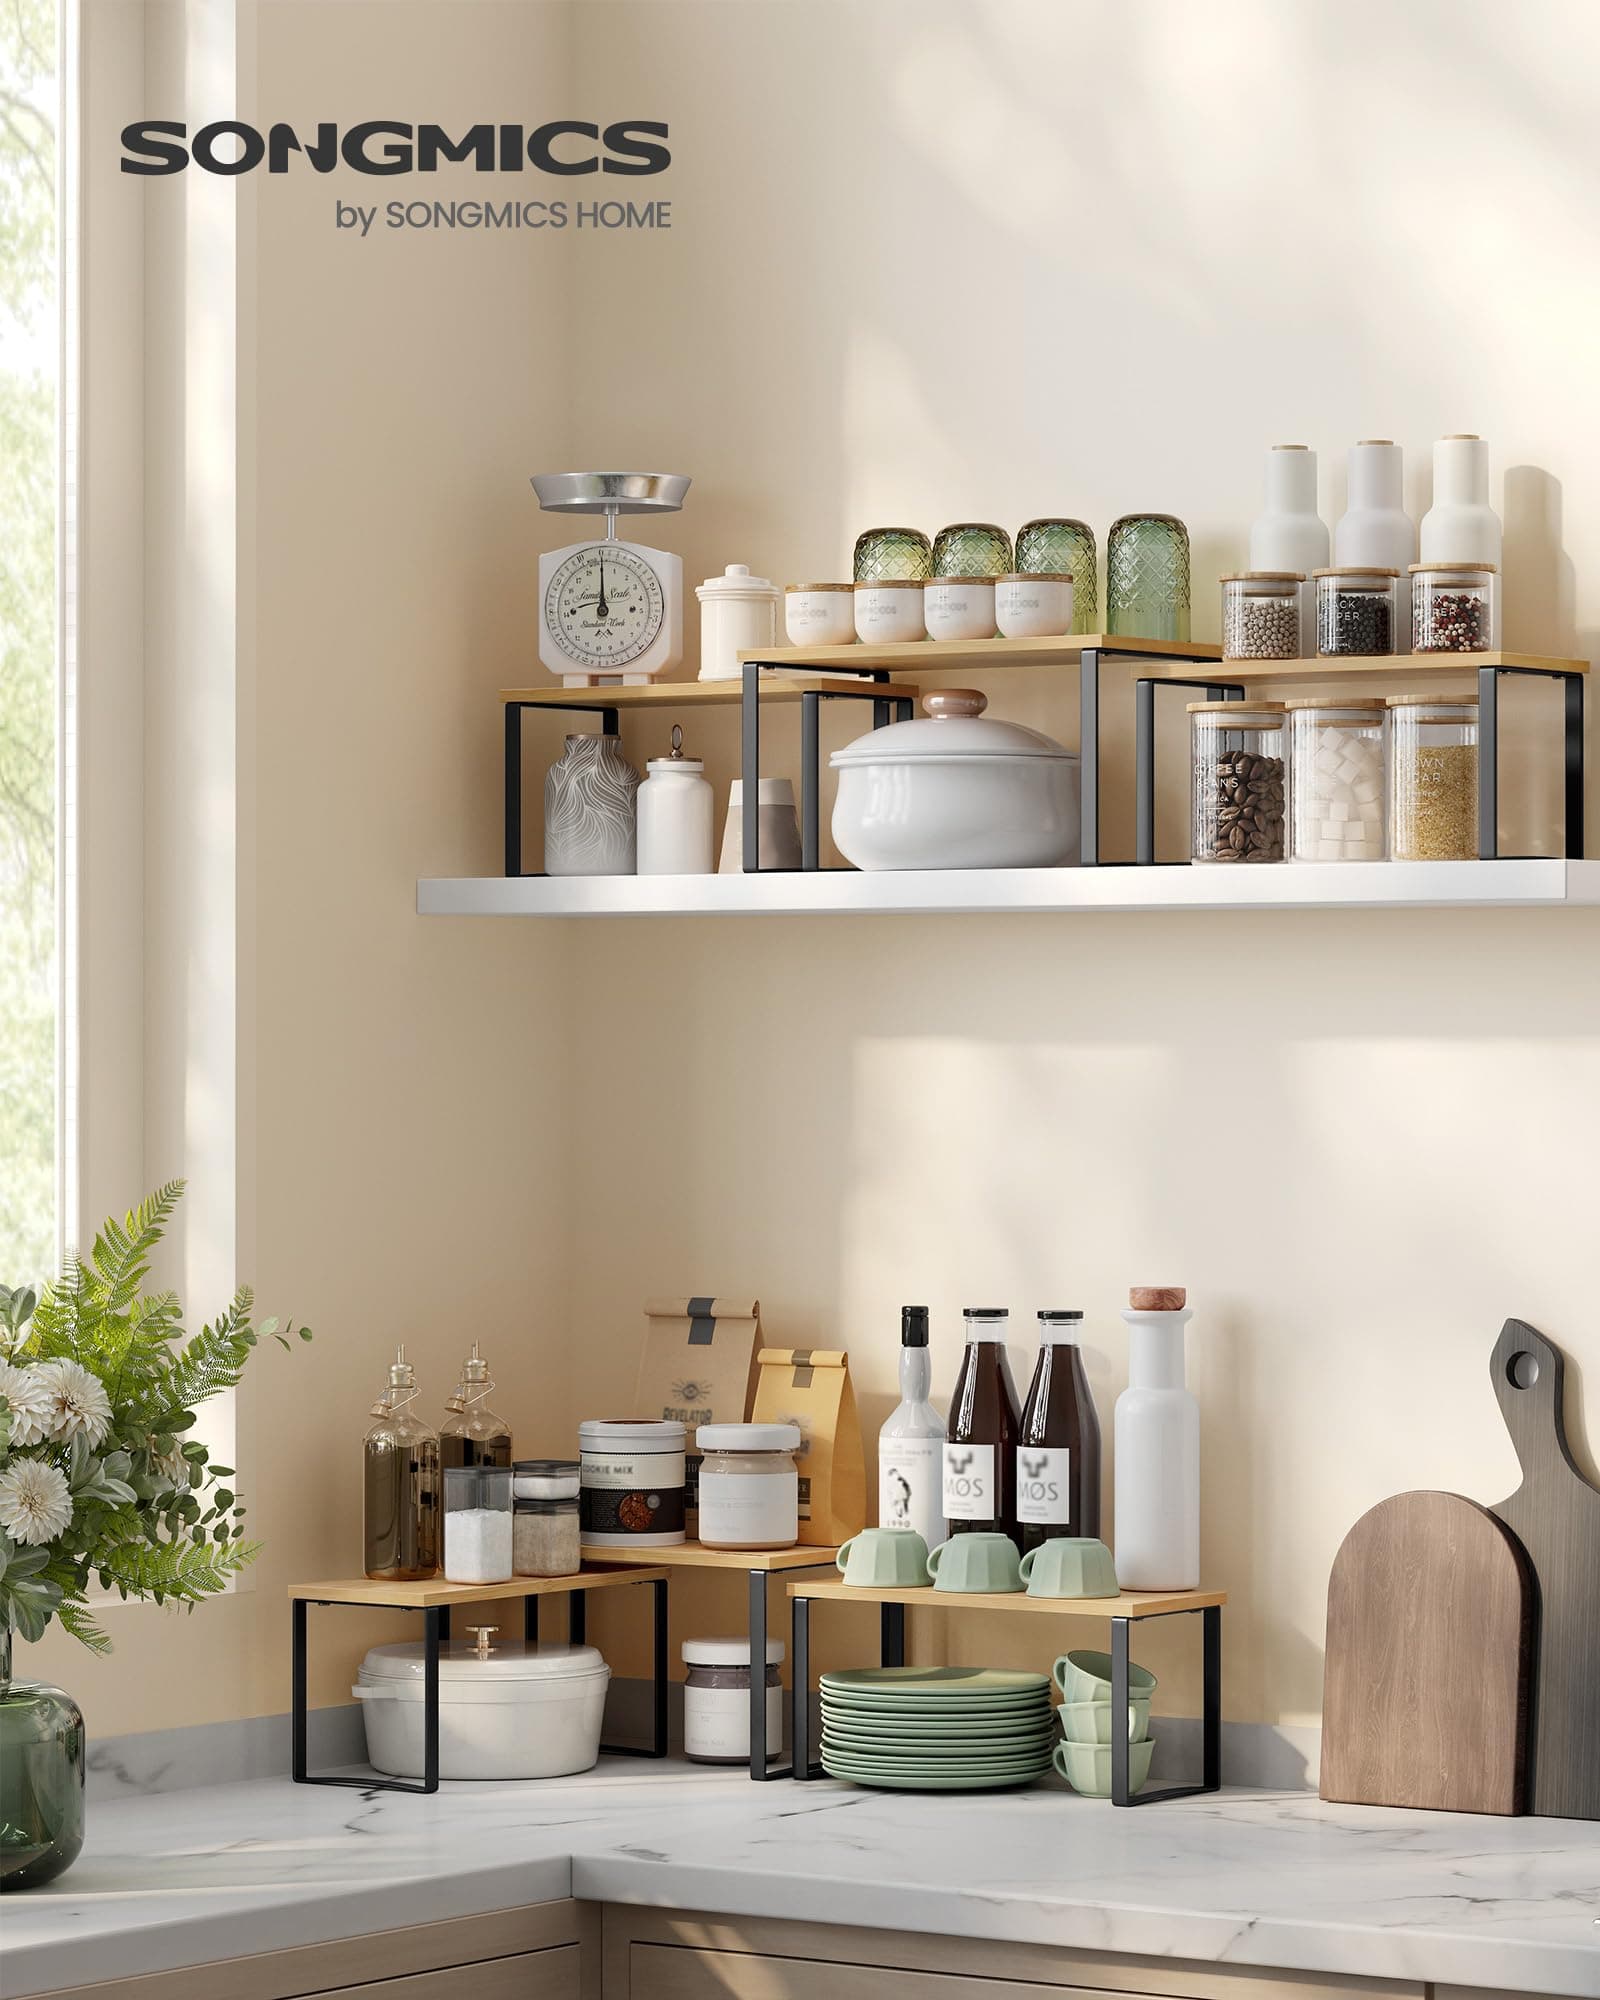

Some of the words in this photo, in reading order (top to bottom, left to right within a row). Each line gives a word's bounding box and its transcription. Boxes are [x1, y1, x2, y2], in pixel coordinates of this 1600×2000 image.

[1321, 600, 1356, 610] BACK
[1318, 611, 1360, 621] PEPER
[614, 1465, 633, 1475] MIX
